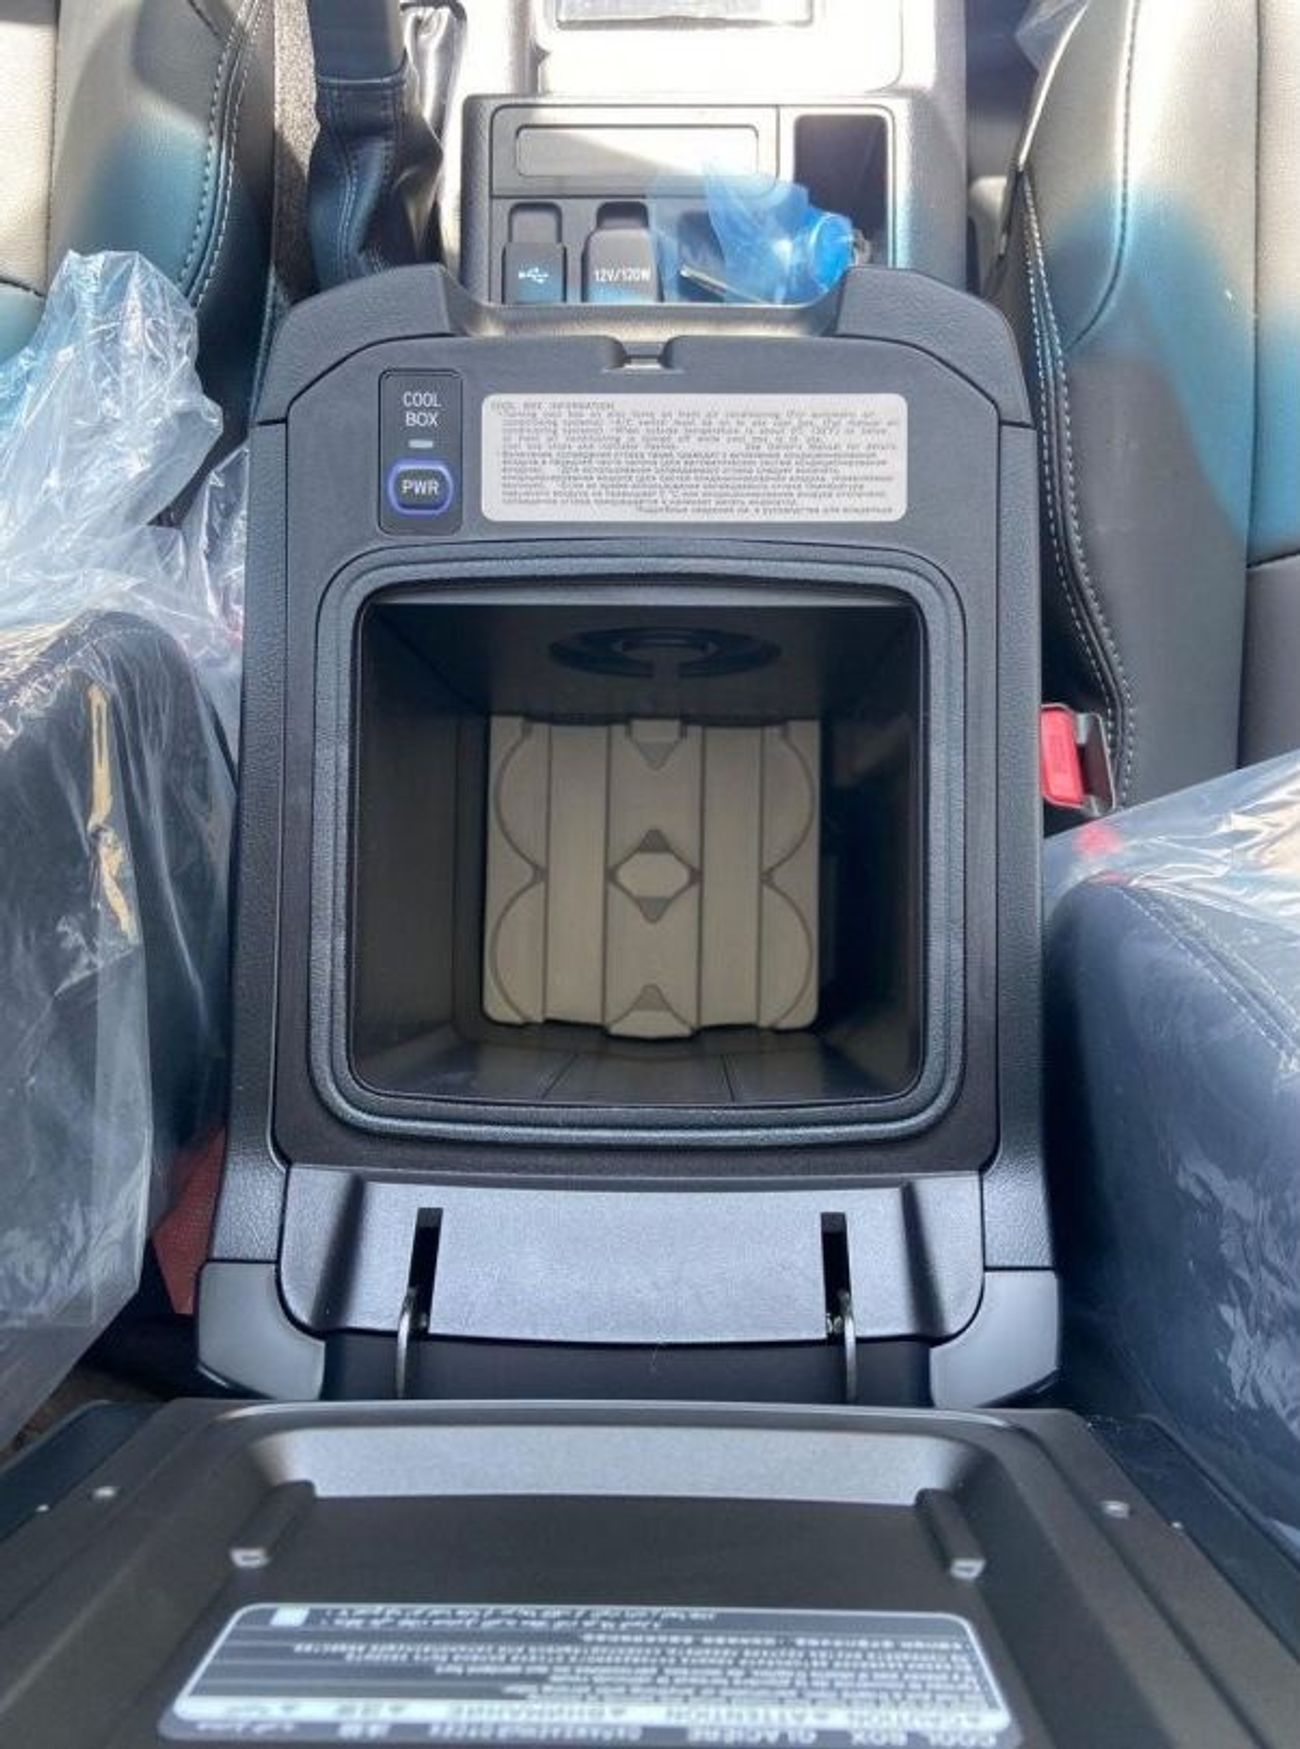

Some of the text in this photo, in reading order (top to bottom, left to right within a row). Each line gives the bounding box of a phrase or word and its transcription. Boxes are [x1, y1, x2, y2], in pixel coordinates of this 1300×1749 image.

[402, 390, 443, 408] COOL
[405, 411, 439, 427] BOX
[401, 479, 440, 496] PWR
[849, 1729, 998, 1747] COOL BOX
